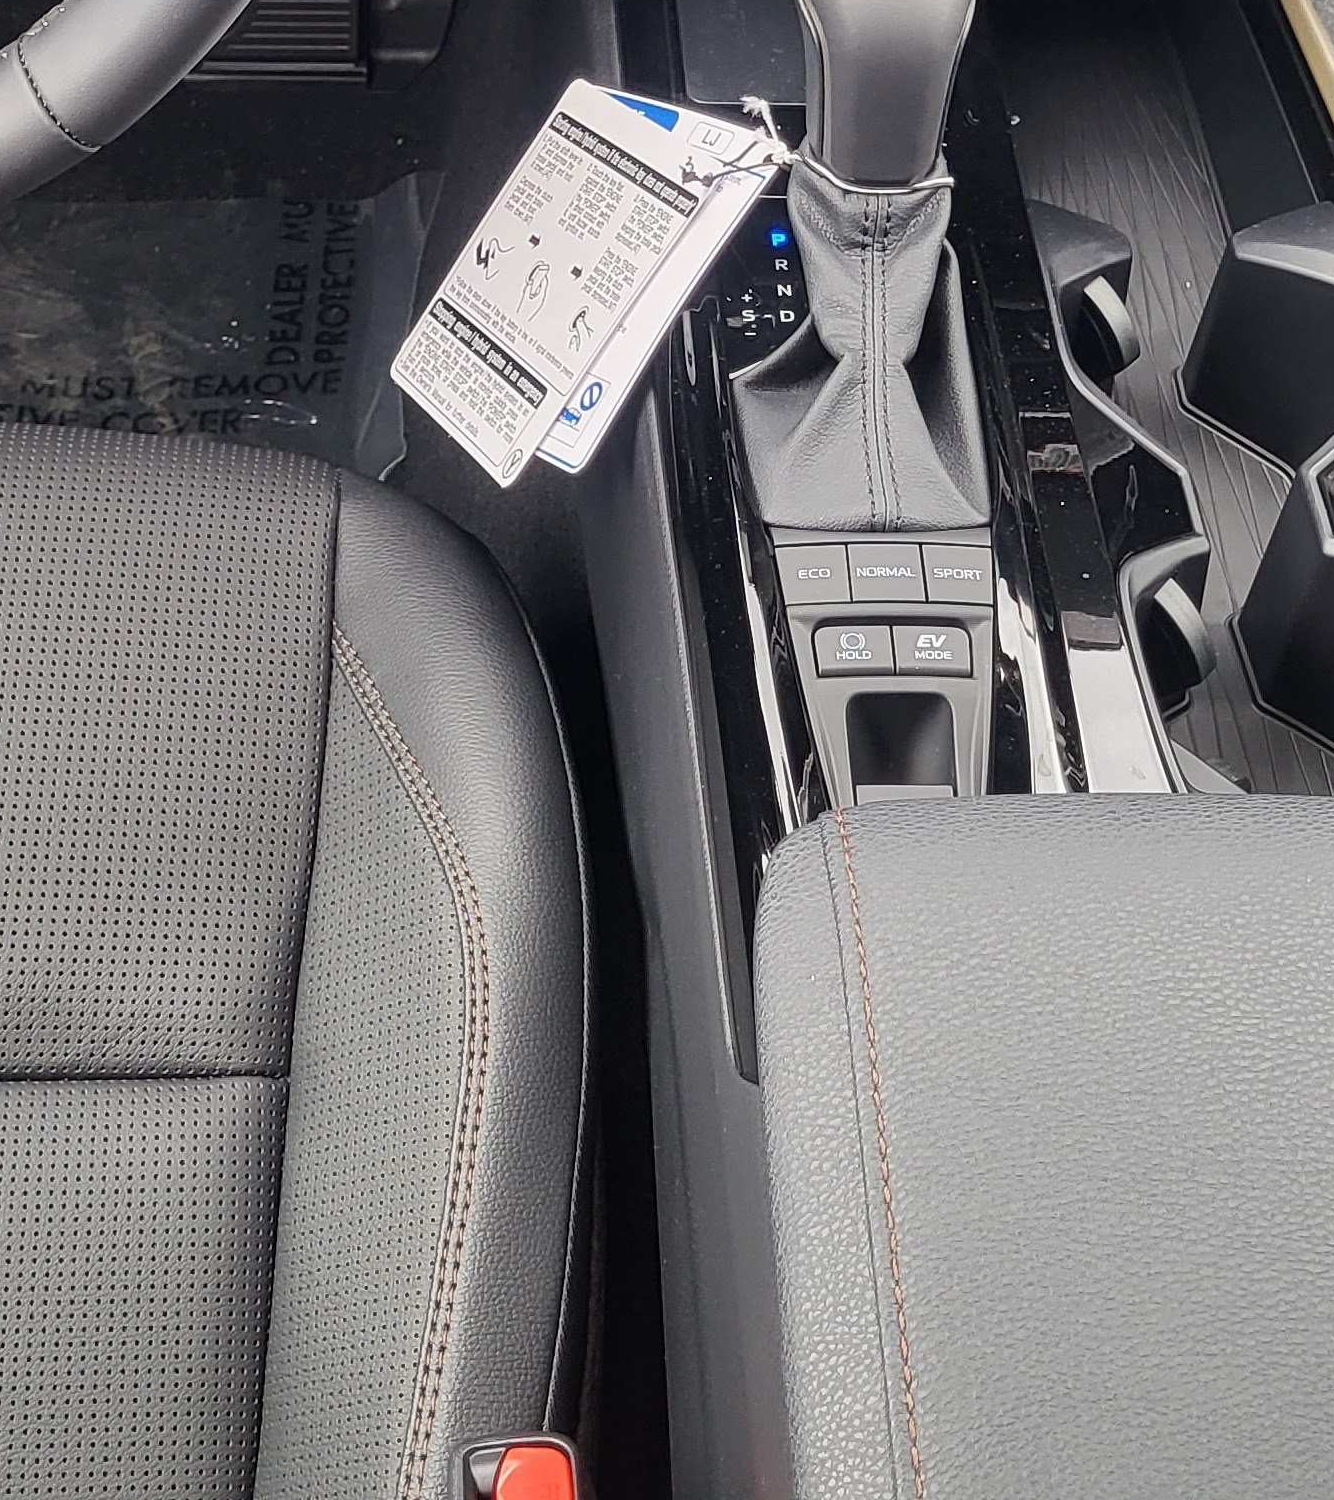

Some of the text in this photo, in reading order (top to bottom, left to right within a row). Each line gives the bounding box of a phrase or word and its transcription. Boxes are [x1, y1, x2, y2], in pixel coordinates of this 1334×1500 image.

[771, 232, 787, 247] P
[776, 258, 788, 271] R
[778, 284, 792, 297] N
[265, 262, 310, 367] DEALER
[741, 309, 795, 323] S D
[798, 568, 831, 579] ECO
[856, 566, 916, 577] NORMAL
[933, 568, 983, 581] SPORT
[916, 634, 948, 648] EV
[836, 650, 872, 660] HOLD
[914, 650, 953, 660] MODE
